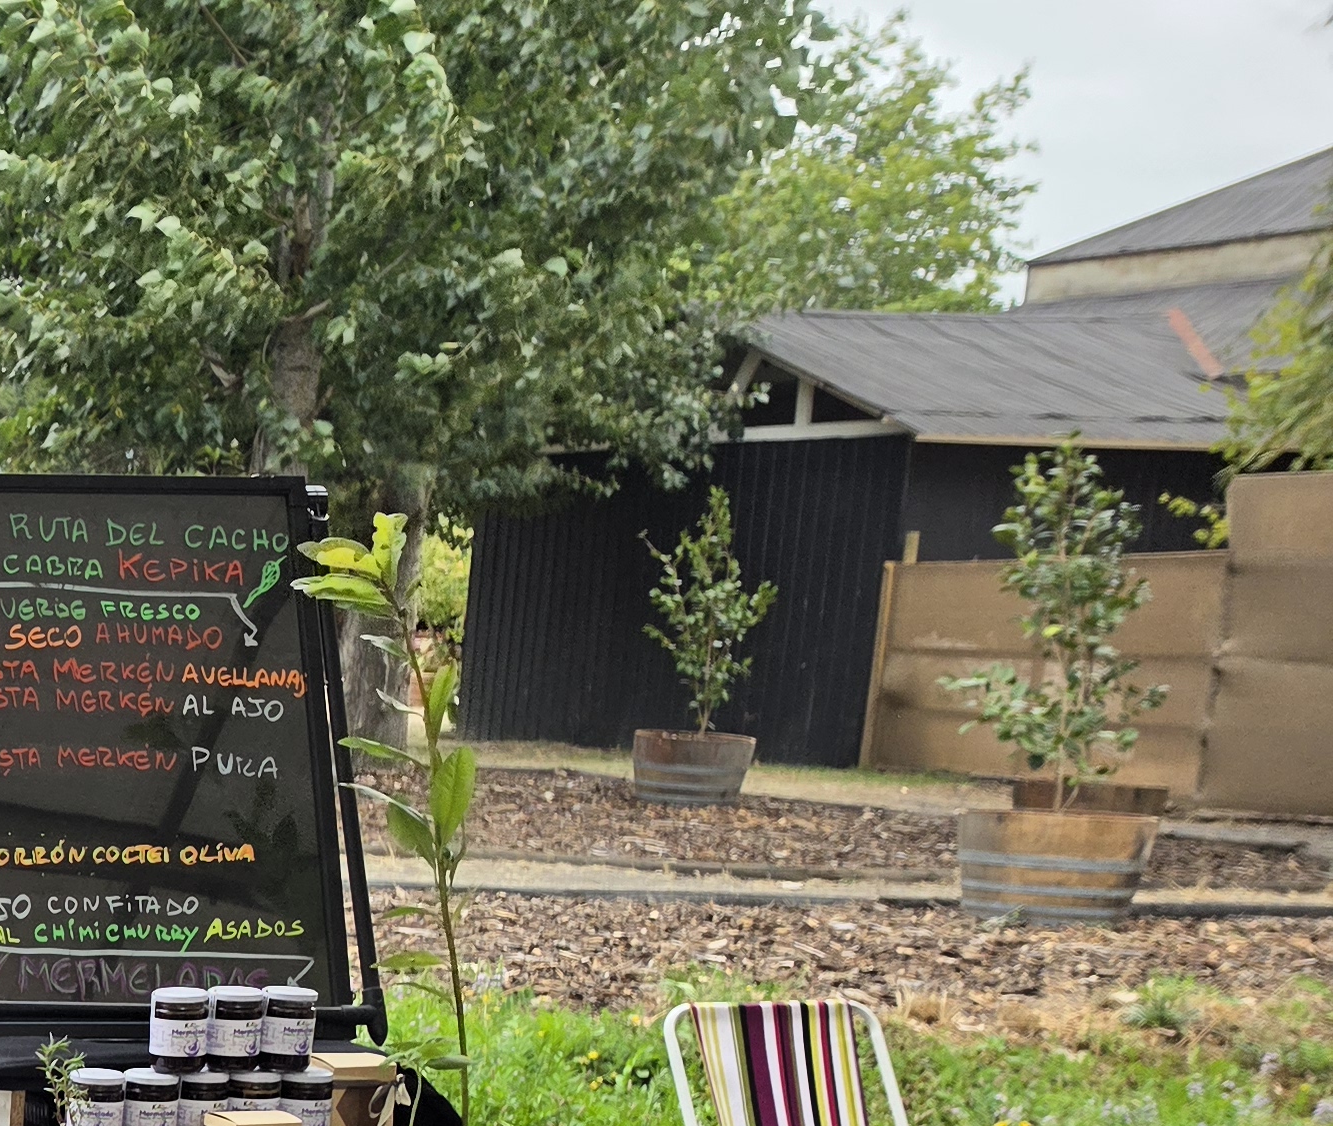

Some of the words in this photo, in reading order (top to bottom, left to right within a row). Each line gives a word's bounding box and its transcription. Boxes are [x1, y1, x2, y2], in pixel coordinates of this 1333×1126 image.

[10, 512, 90, 545] RUTA
[106, 518, 166, 547] DEL
[185, 525, 289, 553] CACHO
[3, 554, 104, 580] CABRA
[3, 597, 87, 622] VERDE
[101, 598, 201, 621] FRESCO
[4, 623, 83, 651] SECO
[96, 623, 223, 650] AHUMADO
[182, 695, 215, 717] AL
[231, 694, 285, 722] AJO
[203, 917, 305, 942] ASADOS
